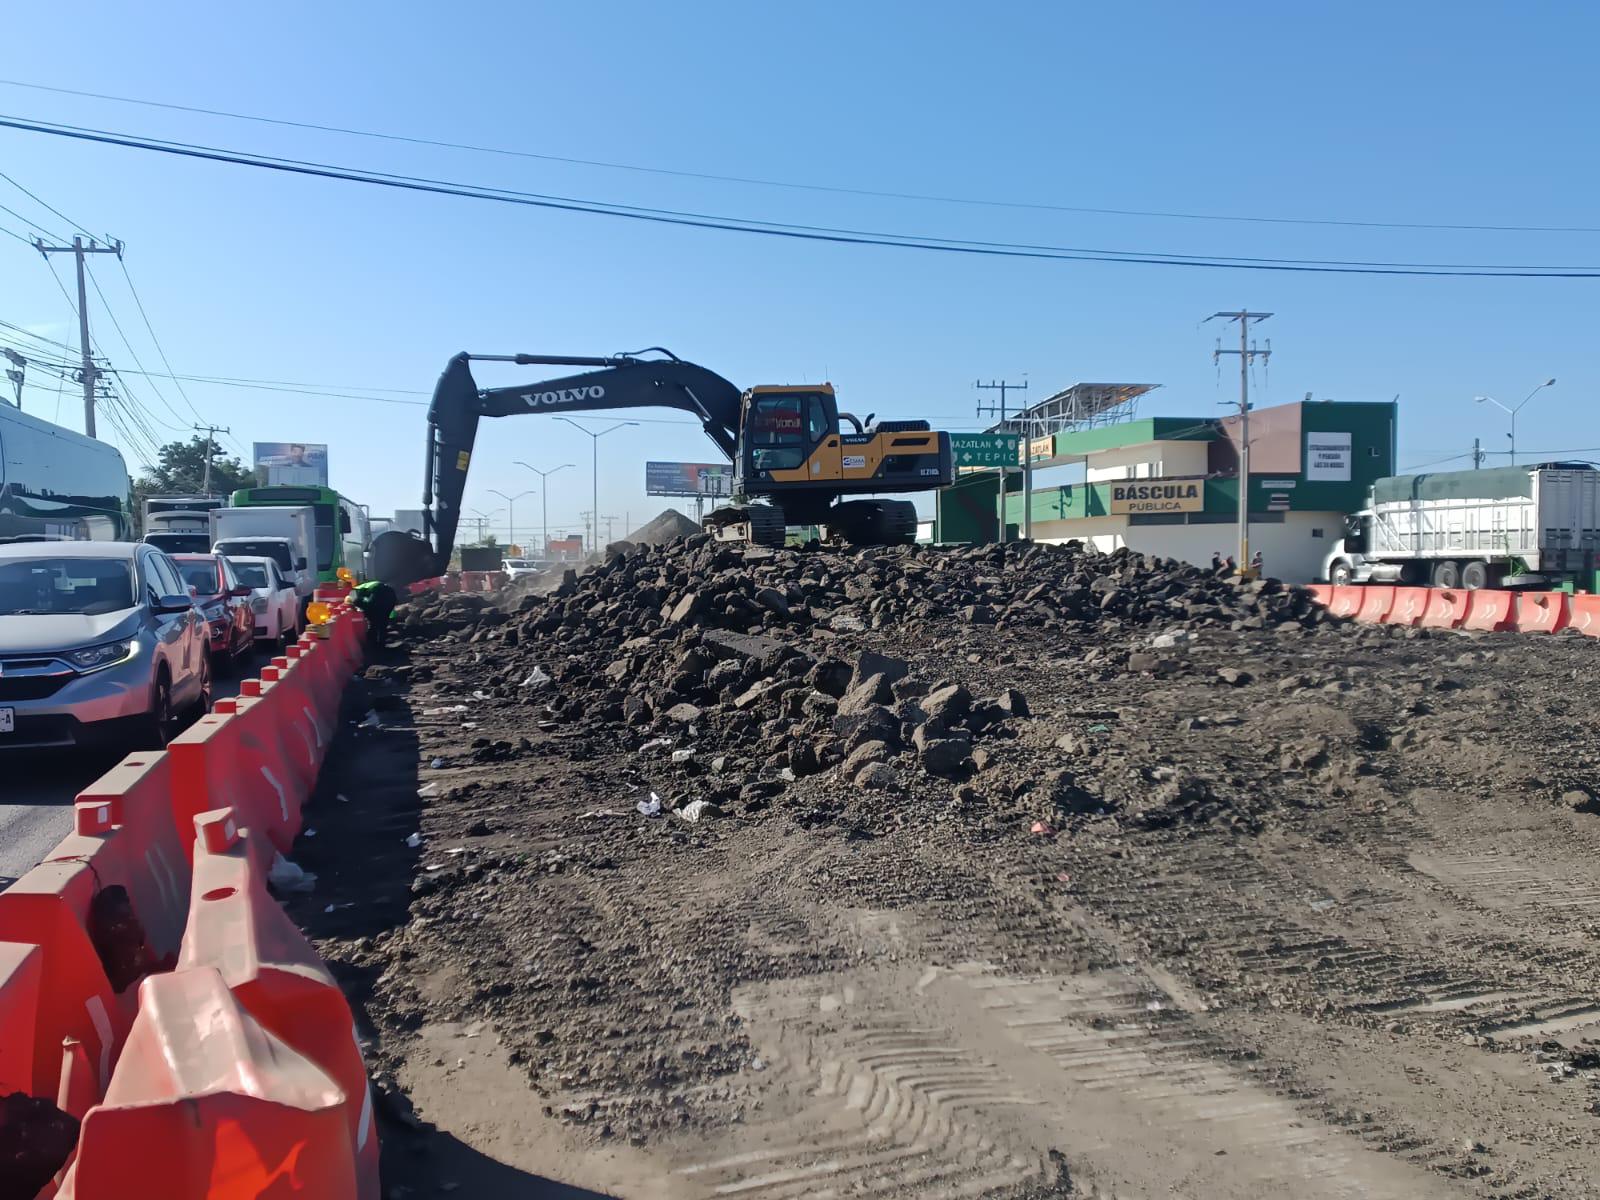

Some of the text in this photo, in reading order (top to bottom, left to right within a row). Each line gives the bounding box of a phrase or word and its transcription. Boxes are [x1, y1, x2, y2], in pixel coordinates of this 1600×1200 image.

[520, 385, 605, 407] VOLVO
[976, 453, 1015, 461] TEPIC
[1113, 484, 1198, 500] BÁSCULA
